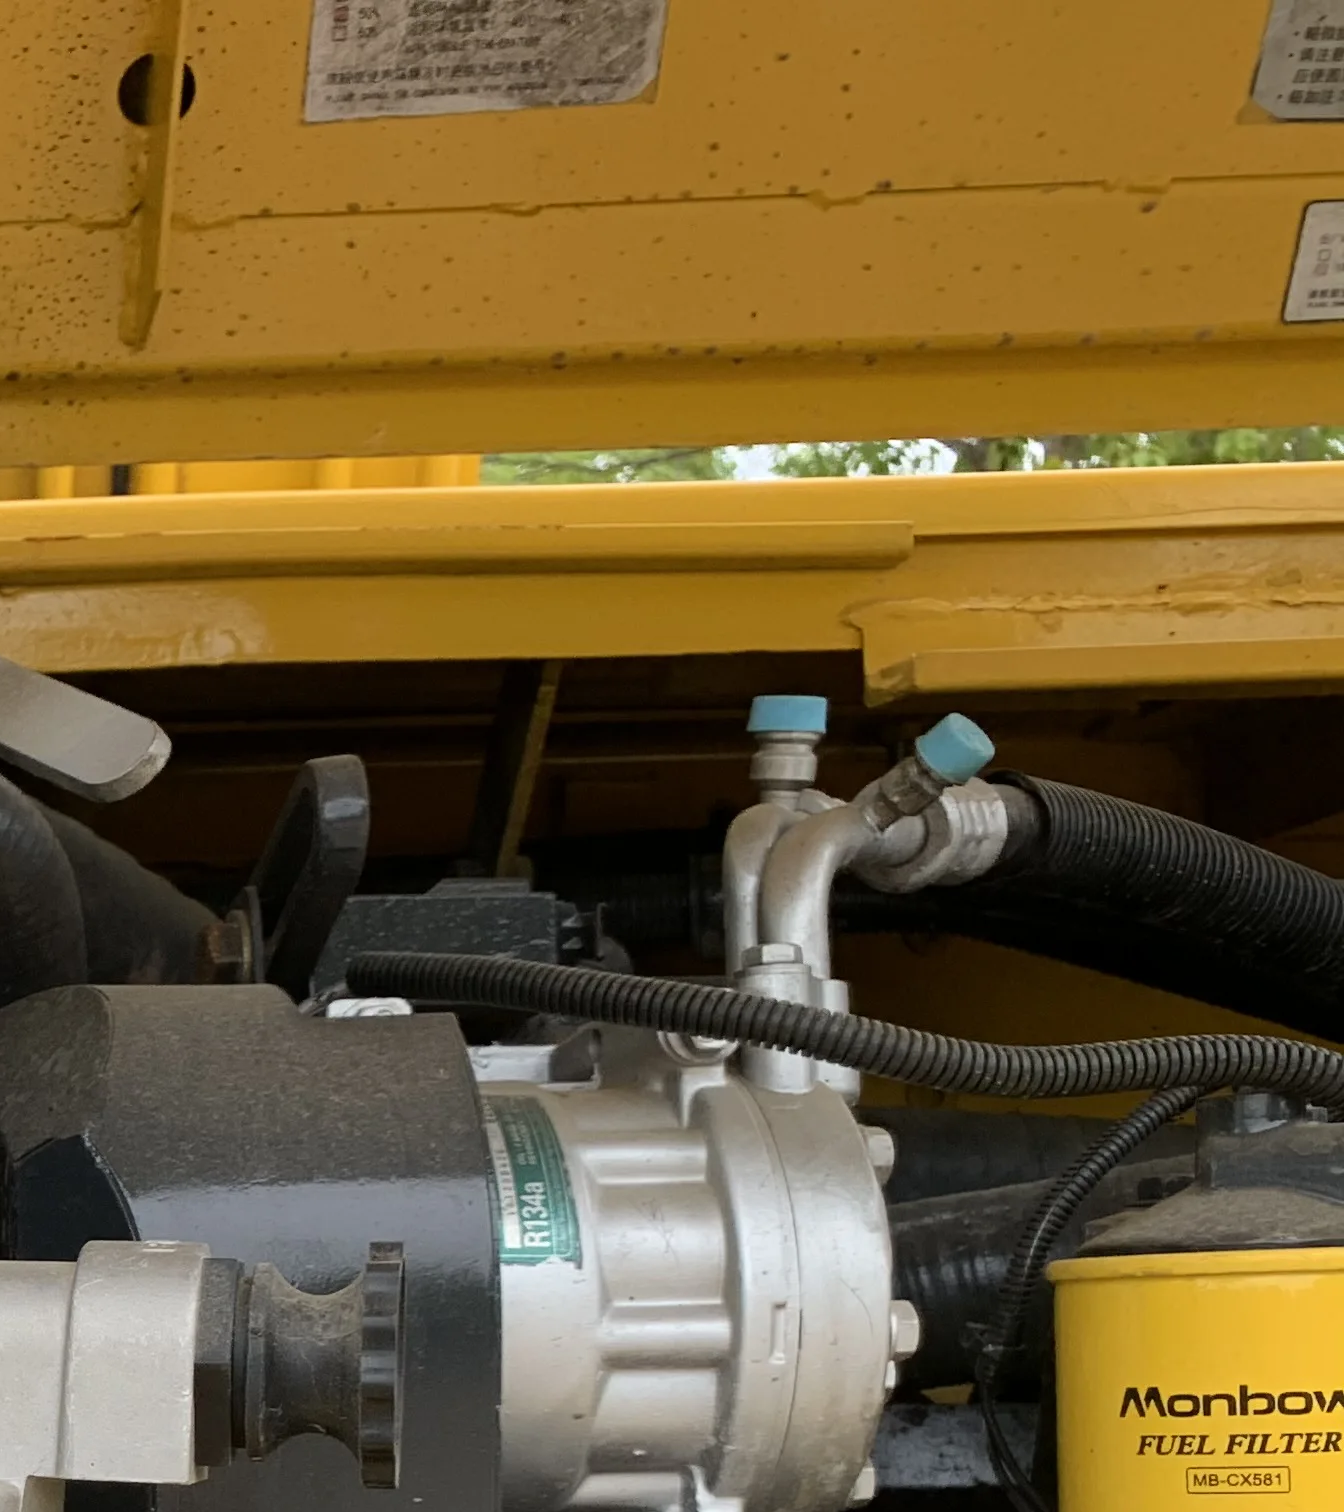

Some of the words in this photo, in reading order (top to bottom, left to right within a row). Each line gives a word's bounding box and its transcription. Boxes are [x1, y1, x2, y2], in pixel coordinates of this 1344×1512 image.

[519, 1181, 552, 1248] R134a
[1119, 1384, 1344, 1418] Monbow
[1136, 1434, 1216, 1456] FUEL
[1223, 1431, 1343, 1455] FILTER
[1192, 1472, 1282, 1487] MB-CX581
